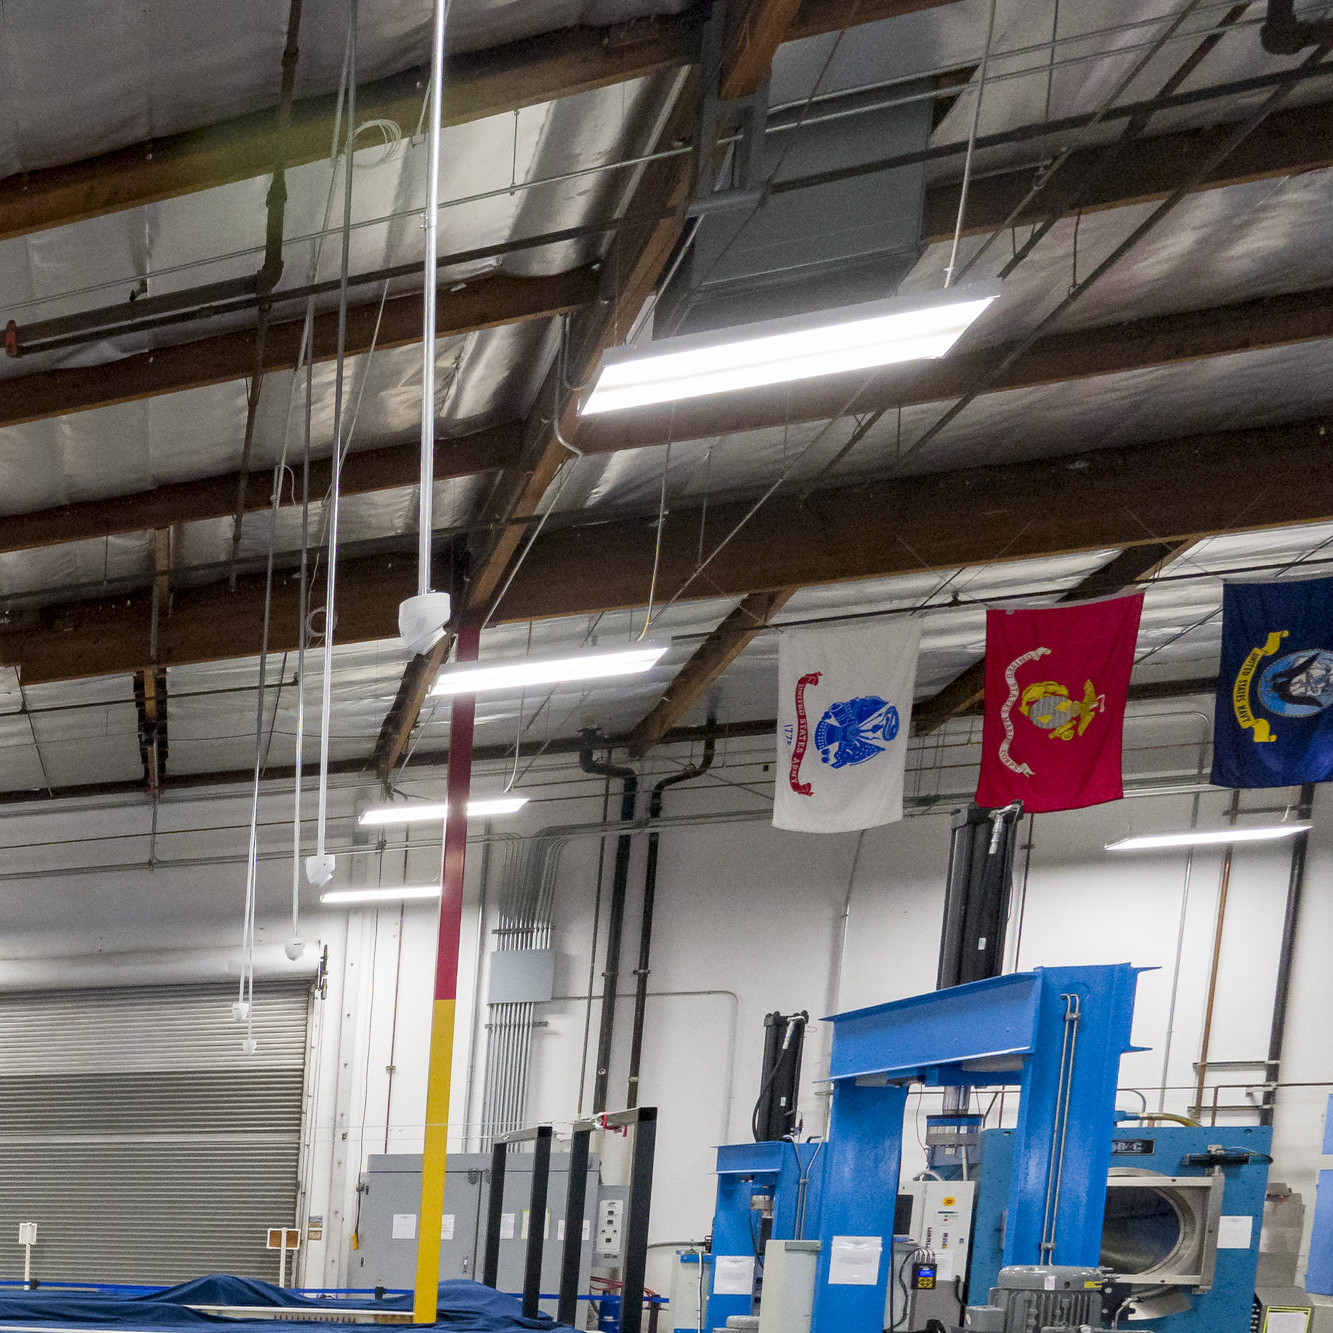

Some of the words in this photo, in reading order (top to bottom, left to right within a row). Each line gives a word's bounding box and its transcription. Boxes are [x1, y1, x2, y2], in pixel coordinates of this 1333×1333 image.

[797, 683, 805, 716] UNITED
[1236, 680, 1248, 702] STATES
[1236, 705, 1252, 723] NAVY
[796, 718, 807, 754] STATES
[791, 757, 800, 784] ARMY
